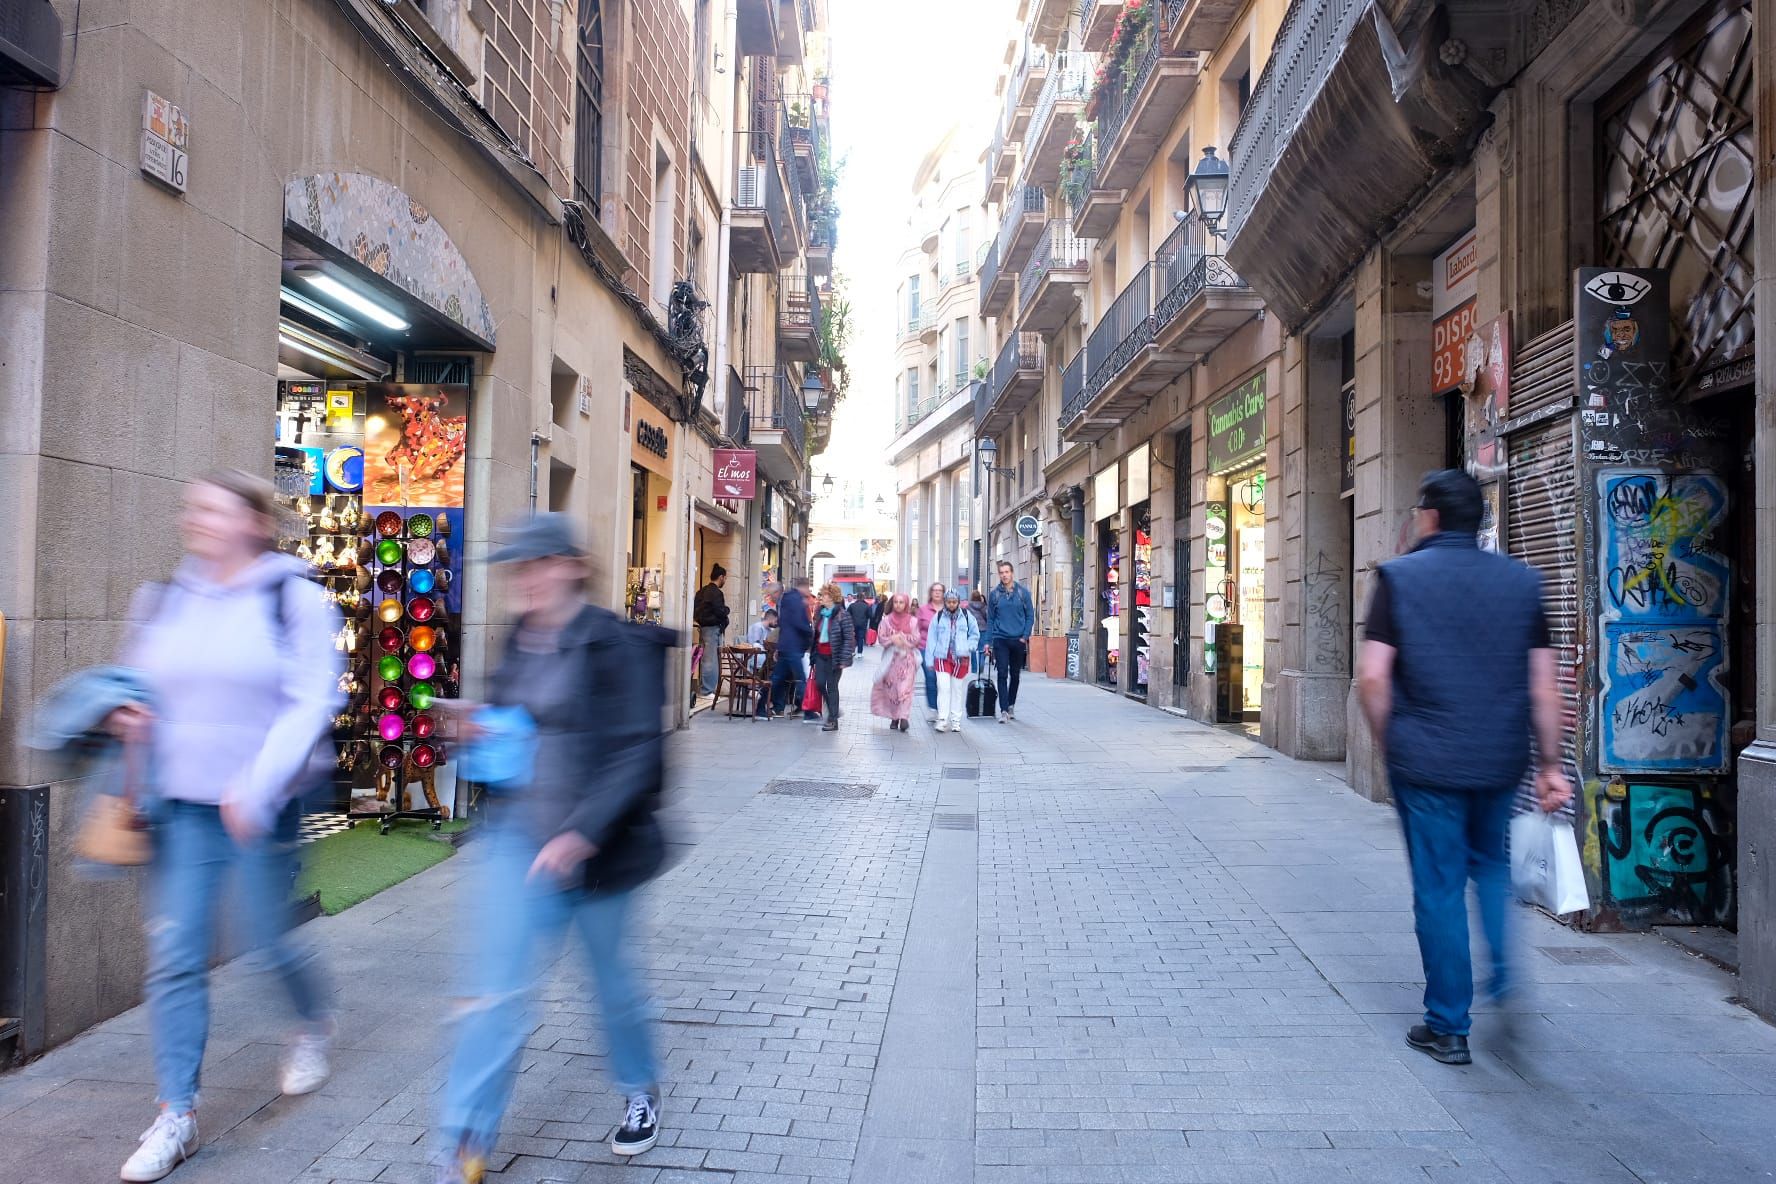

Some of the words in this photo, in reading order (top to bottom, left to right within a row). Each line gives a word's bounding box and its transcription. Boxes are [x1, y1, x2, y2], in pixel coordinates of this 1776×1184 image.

[171, 149, 184, 186] 16
[1434, 351, 1452, 388] 93
[1211, 400, 1244, 437] Cannabis
[1244, 391, 1265, 419] Care
[1230, 427, 1243, 454] CBD
[717, 465, 729, 479] El
[730, 470, 751, 480] mos
